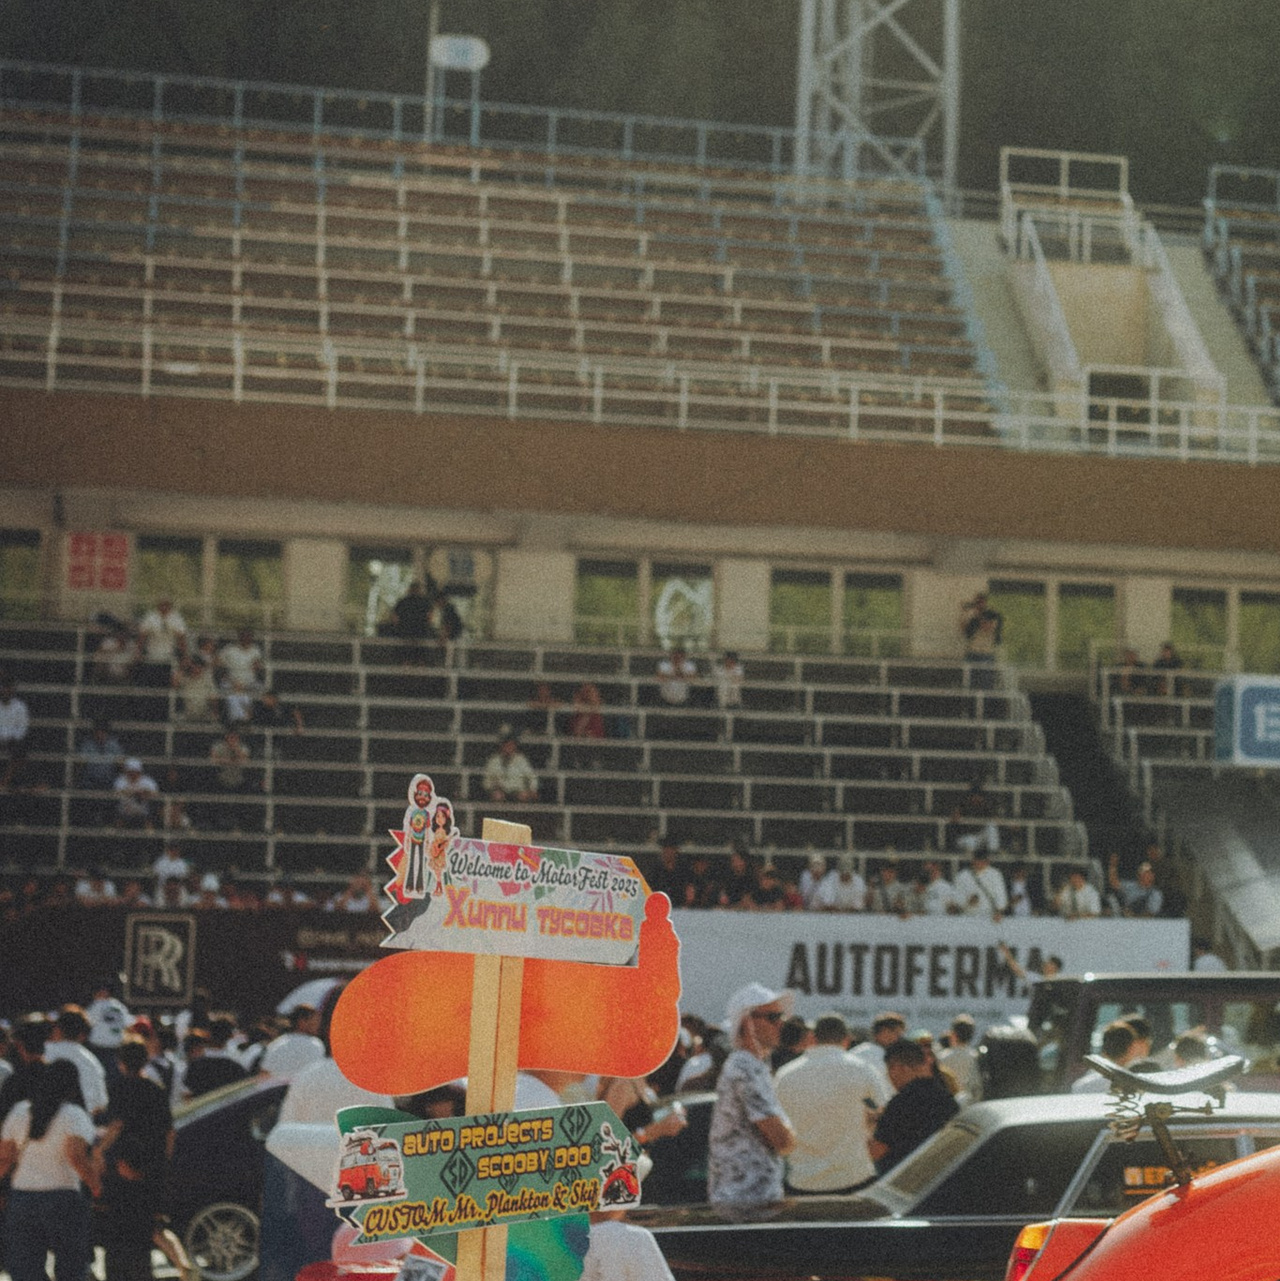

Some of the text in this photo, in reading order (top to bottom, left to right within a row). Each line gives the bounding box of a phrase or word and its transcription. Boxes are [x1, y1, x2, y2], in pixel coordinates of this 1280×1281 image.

[450, 852, 639, 898] Welcome to MotorFest 2025
[477, 1149, 550, 1180] SCOOBY
[554, 1145, 592, 1169] DOO
[364, 1197, 449, 1237] CUSTOM
[485, 1186, 550, 1220] Plankton
[551, 1181, 570, 1210] &
